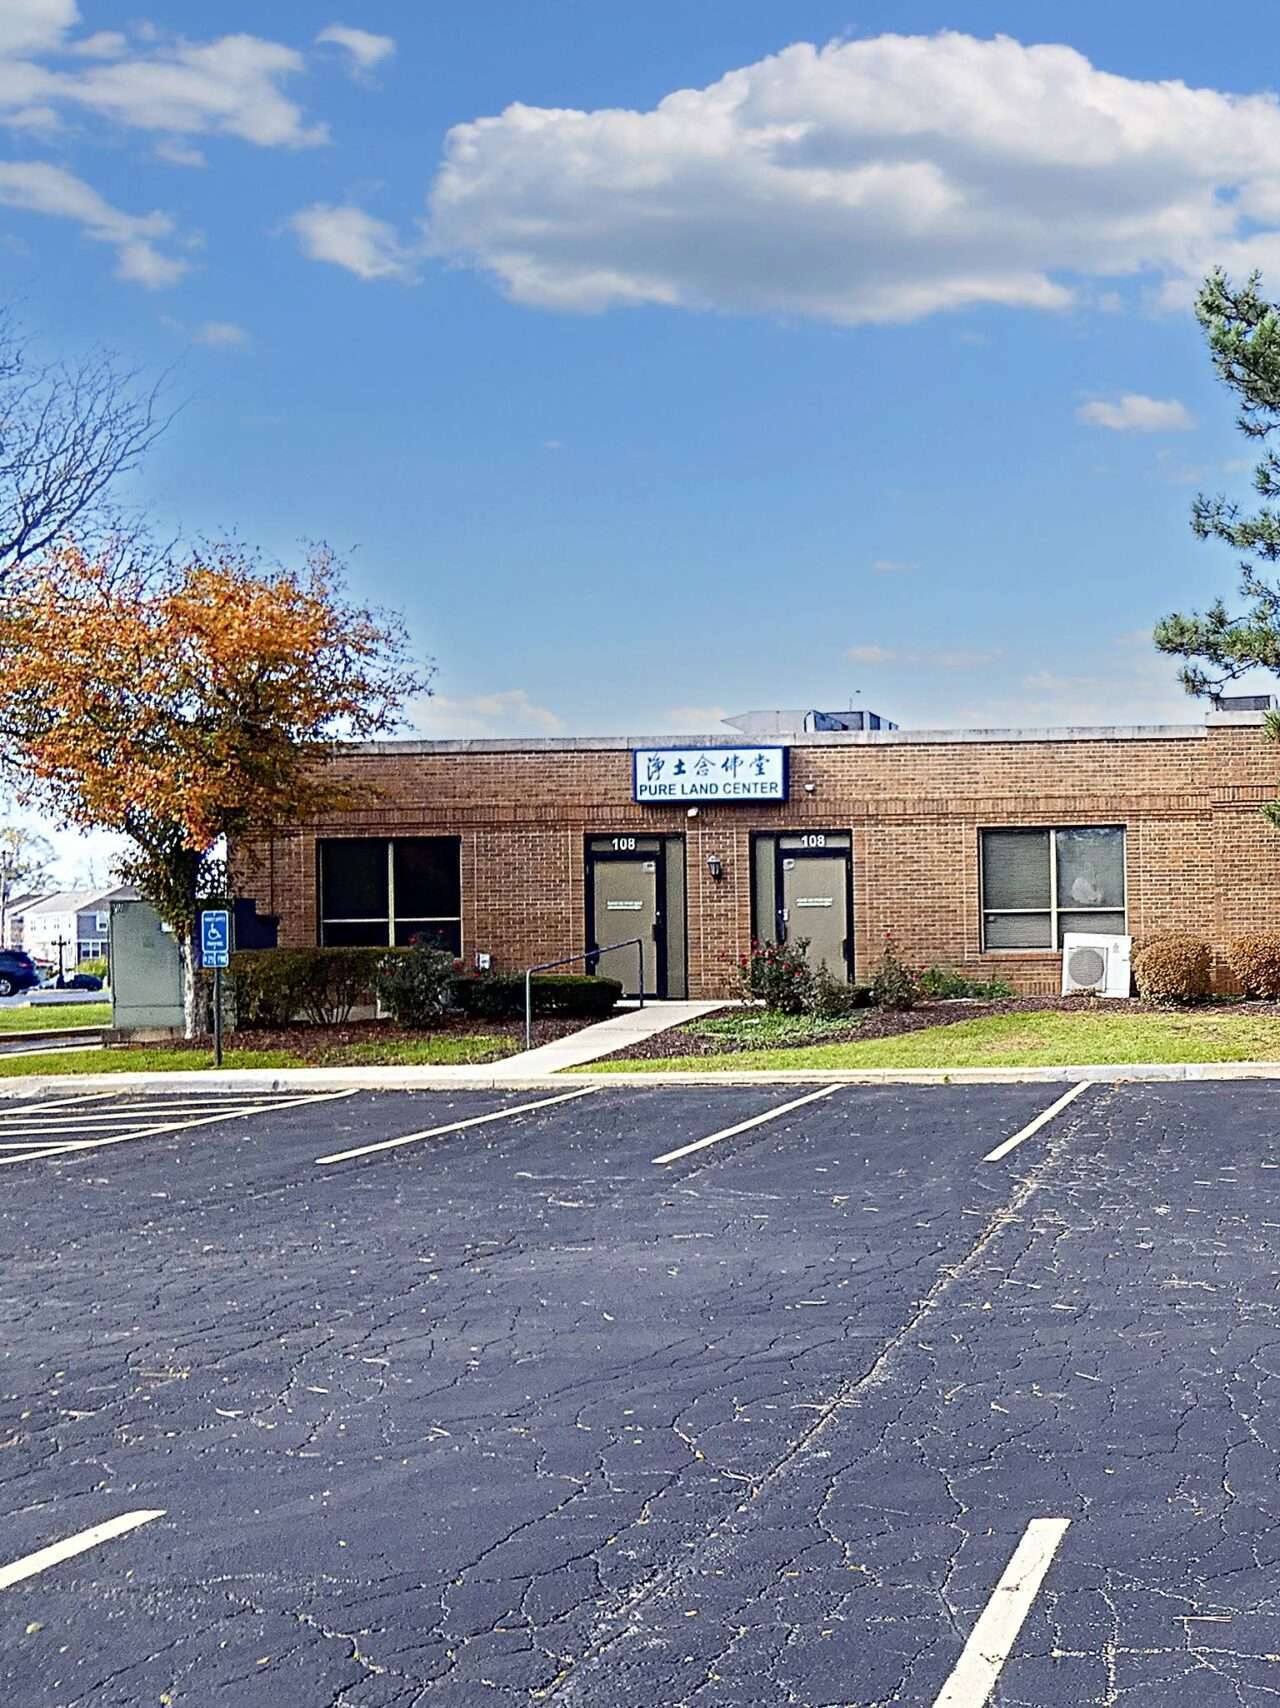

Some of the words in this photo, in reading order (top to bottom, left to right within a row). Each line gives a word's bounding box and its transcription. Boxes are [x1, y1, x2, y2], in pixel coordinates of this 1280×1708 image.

[639, 783, 677, 796] PURE
[681, 783, 719, 795] LAND
[722, 782, 779, 794] CENTER
[612, 838, 636, 851] 108
[801, 835, 826, 848] 108
